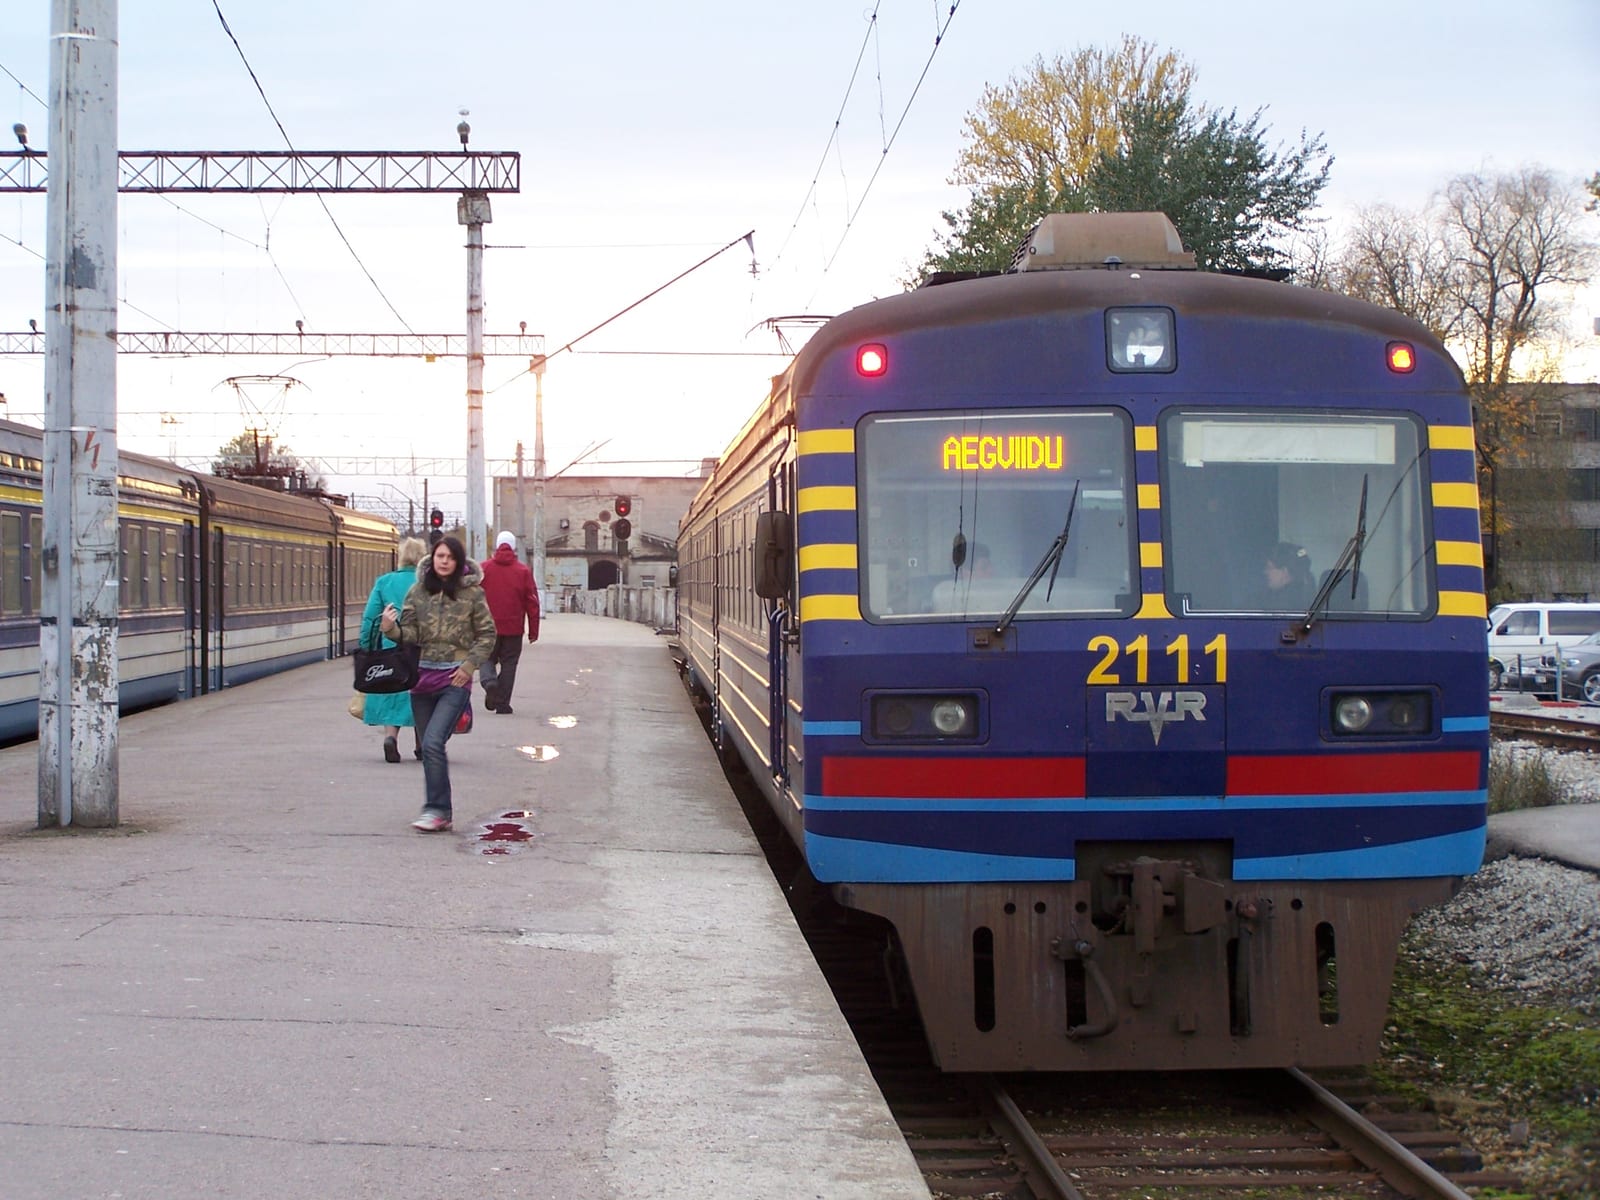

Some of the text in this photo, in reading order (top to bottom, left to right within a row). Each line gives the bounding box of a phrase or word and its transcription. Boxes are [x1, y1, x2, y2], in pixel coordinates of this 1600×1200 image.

[943, 435, 1063, 470] AEGVIIDU
[1086, 633, 1227, 684] 2111
[1105, 691, 1207, 746] RVR
